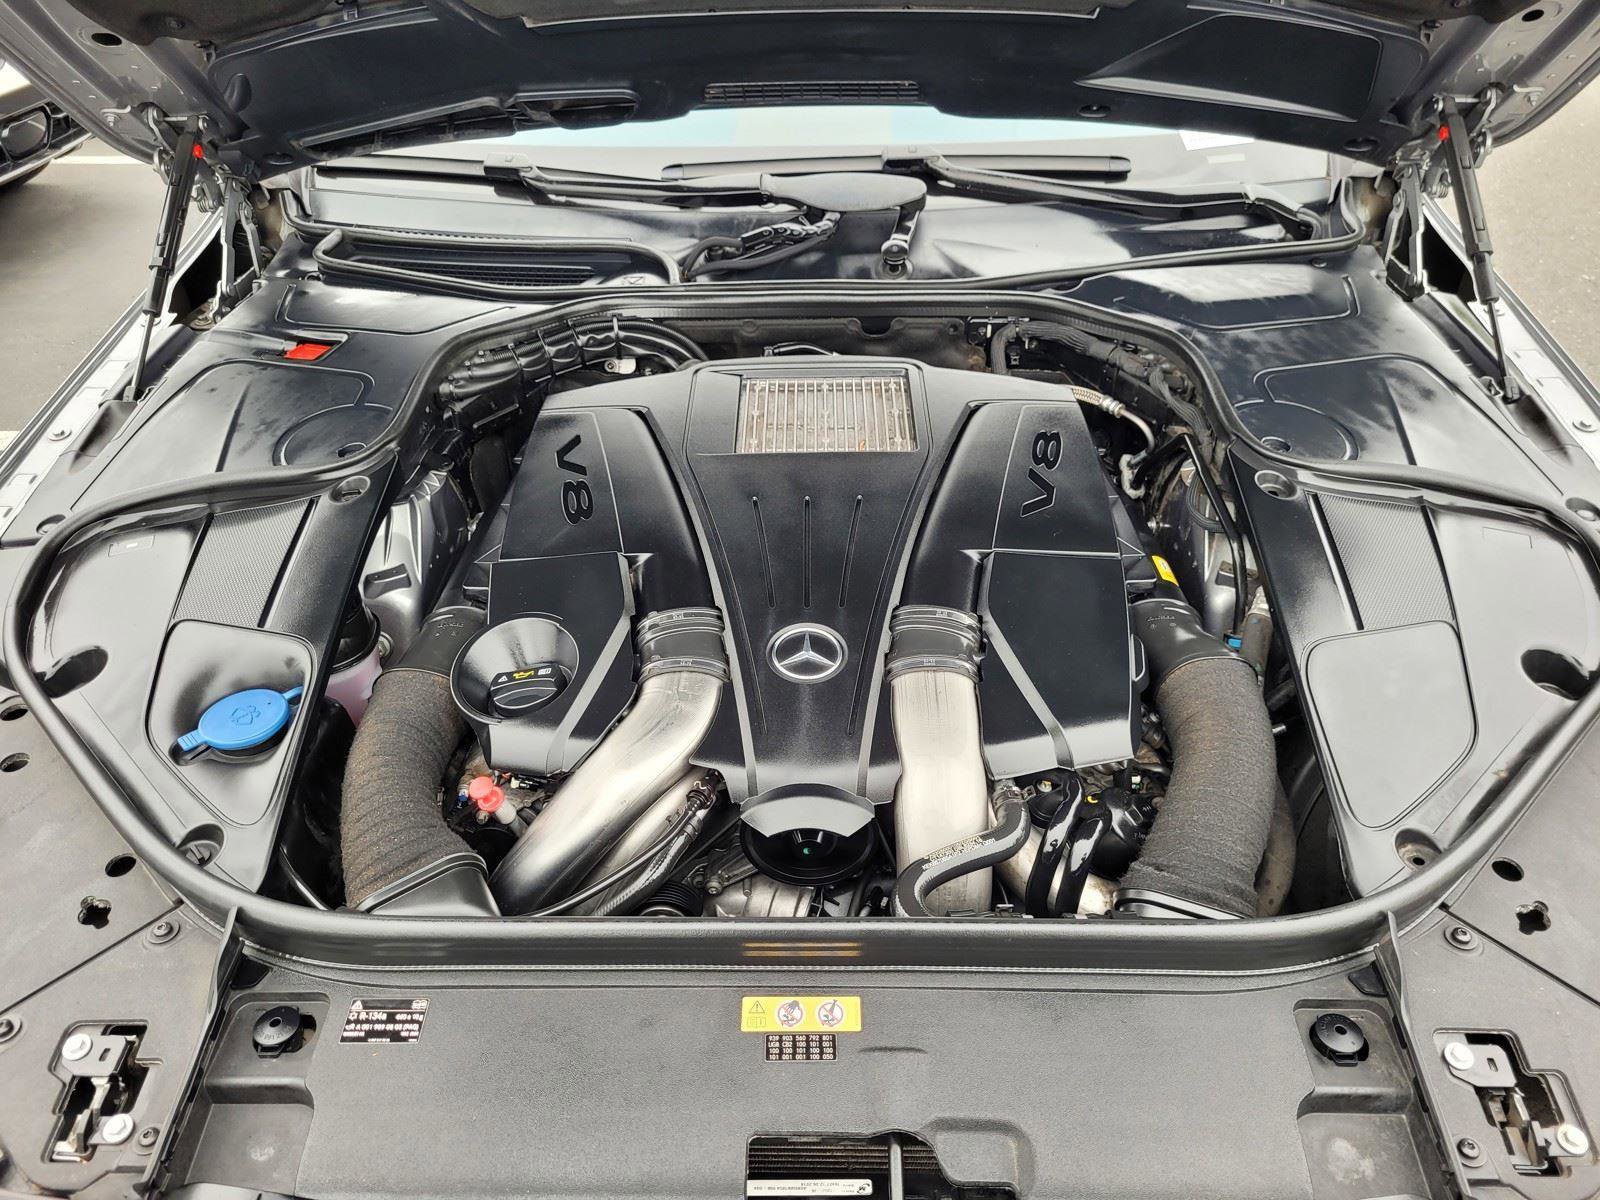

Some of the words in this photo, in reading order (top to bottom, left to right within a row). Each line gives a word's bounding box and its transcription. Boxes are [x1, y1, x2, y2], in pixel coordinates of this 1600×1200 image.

[555, 434, 593, 525] V8
[1020, 430, 1063, 517] V8
[359, 1012, 387, 1020] R-134a
